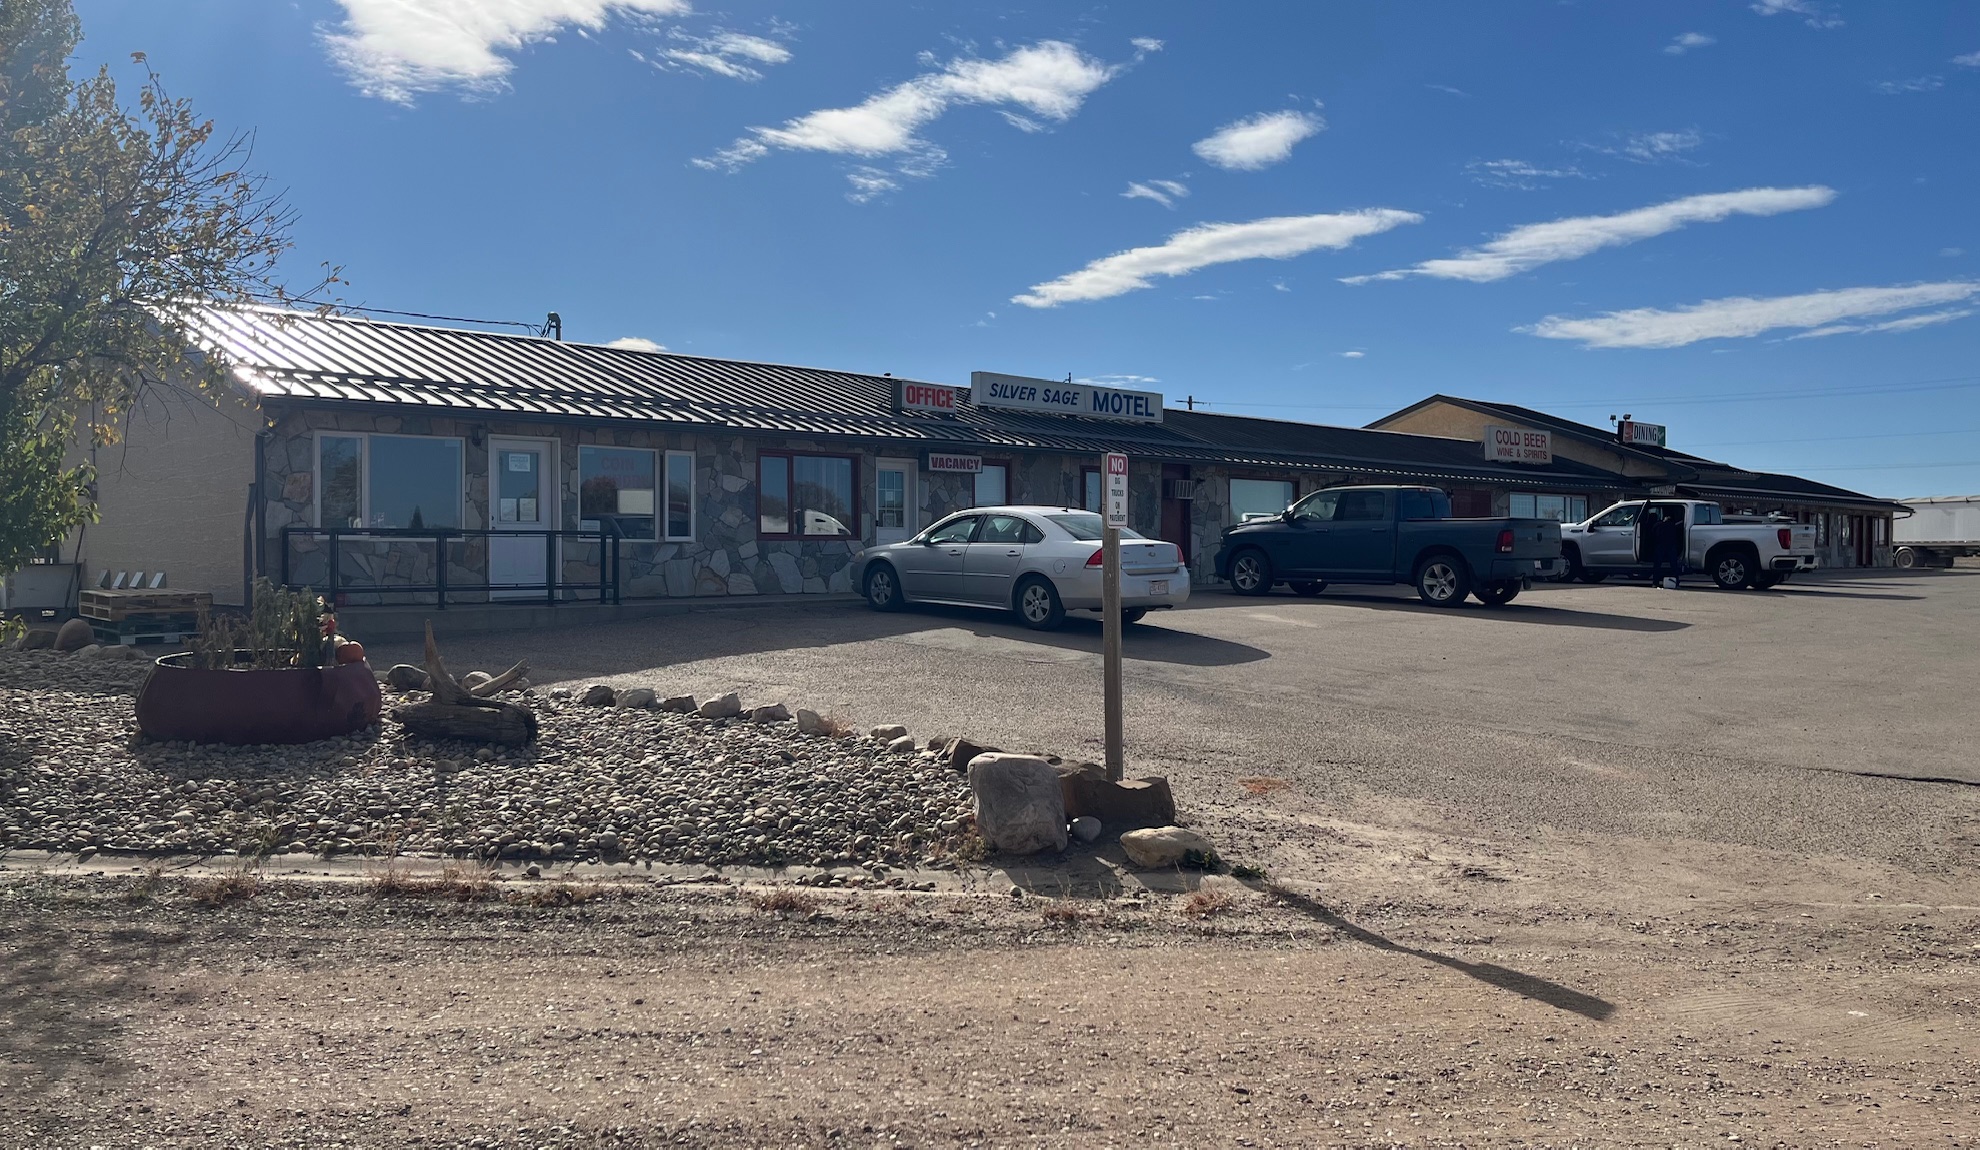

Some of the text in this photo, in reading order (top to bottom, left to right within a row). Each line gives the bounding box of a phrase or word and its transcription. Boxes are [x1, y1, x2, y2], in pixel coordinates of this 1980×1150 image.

[905, 384, 954, 409] OFFICE
[989, 382, 1155, 418] SILVER SAGE MOTEL
[1495, 429, 1547, 449] COLD BEER
[1633, 424, 1657, 442] DINING
[1496, 447, 1547, 460] WINE & SPIRITS
[601, 456, 635, 472] COIN
[930, 456, 980, 471] VACANCY
[1111, 457, 1124, 473] NO
[1111, 489, 1124, 497] TRUCKS
[1114, 501, 1121, 510] ON
[1109, 514, 1126, 522] PAVEMENT
